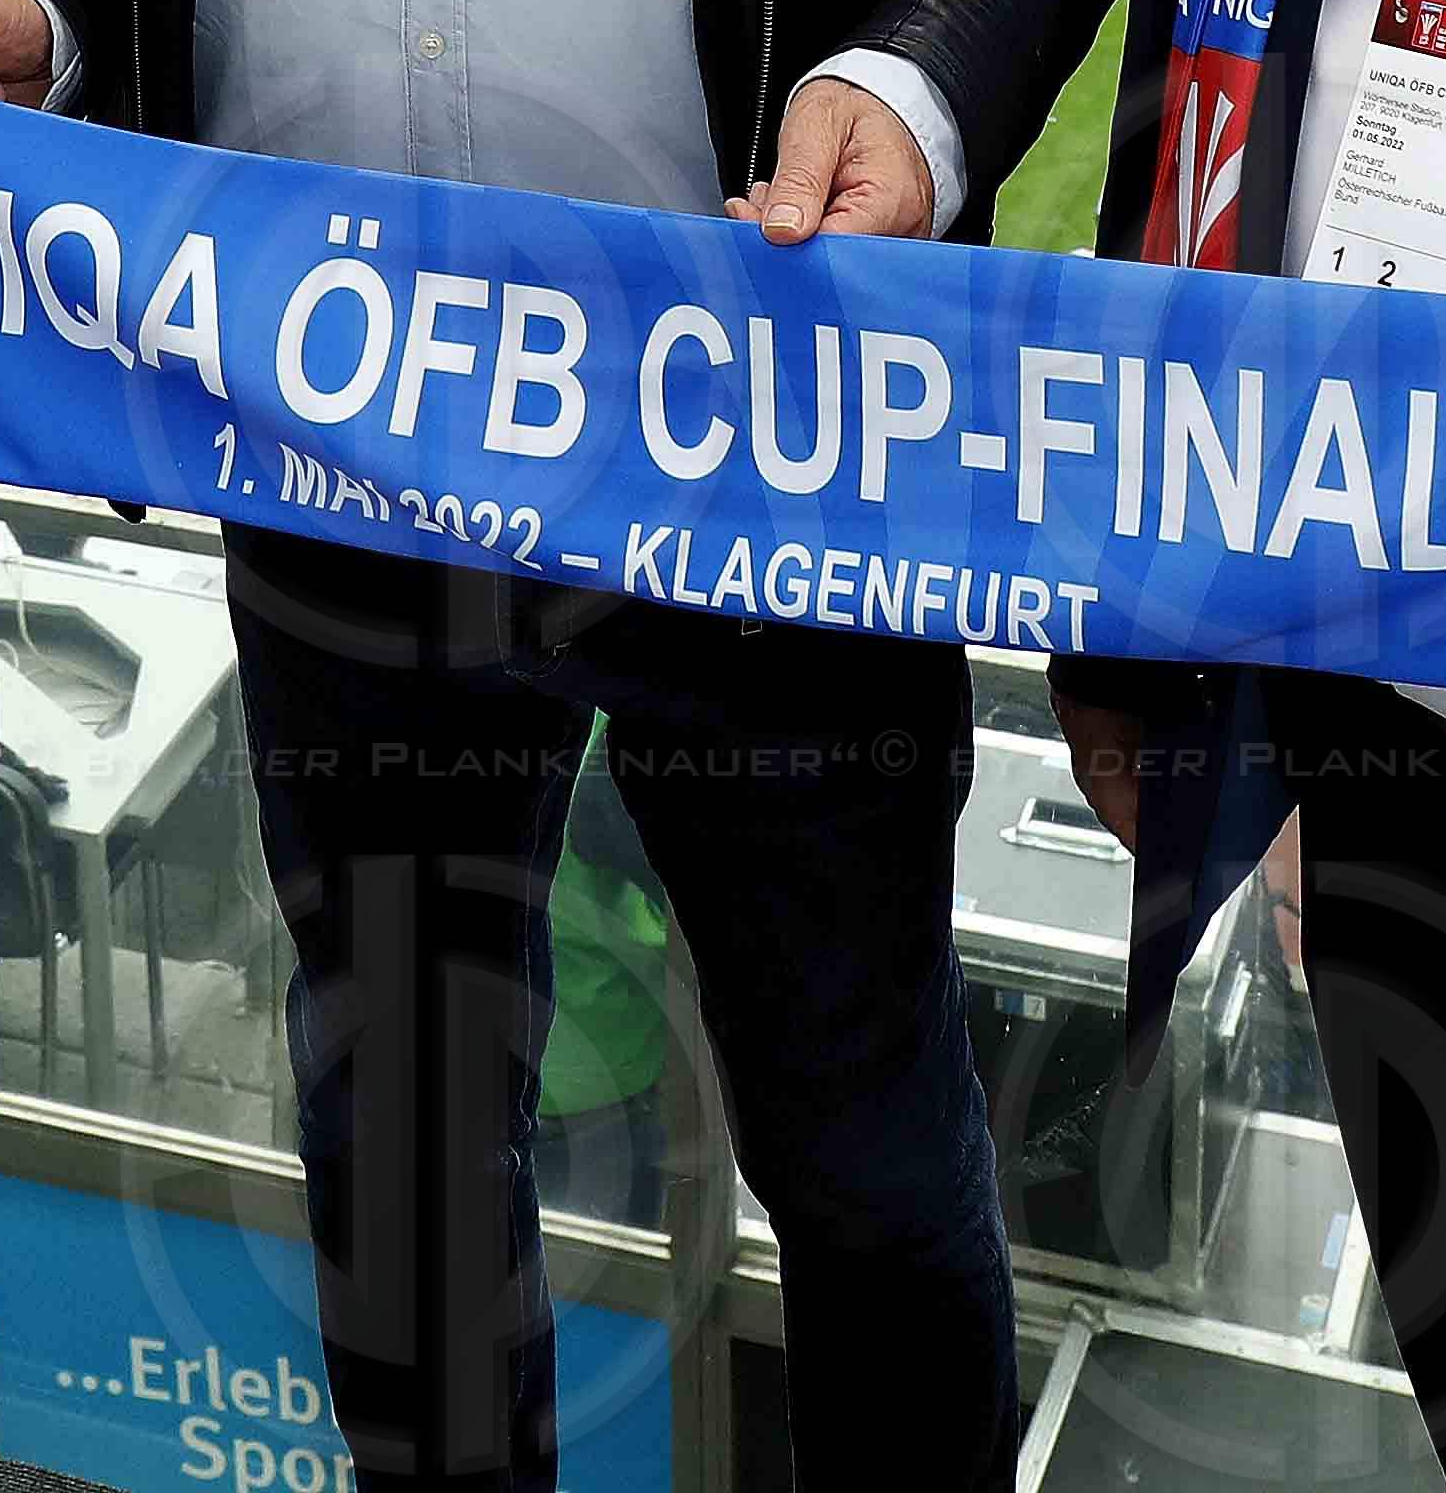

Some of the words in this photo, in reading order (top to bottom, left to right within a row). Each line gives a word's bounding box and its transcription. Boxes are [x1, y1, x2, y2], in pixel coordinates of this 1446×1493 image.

[1368, 69, 1406, 89] UNIQA
[1409, 78, 1435, 96] ÖFB
[1355, 115, 1398, 137] Sonntag
[1351, 129, 1406, 152] 01.05.2022
[1345, 149, 1385, 169] Gerhard
[1342, 162, 1397, 186] MILLETICH
[1334, 189, 1359, 206] Bund
[1332, 245, 1346, 273] 1
[1377, 260, 1397, 288] 2
[275, 214, 590, 460] ÖFB
[213, 421, 255, 495] 1.
[278, 441, 392, 523] MAI
[401, 488, 545, 573] 2022
[623, 523, 1101, 654] KLAGENFURT
[55, 1335, 321, 1426] ...Erleb
